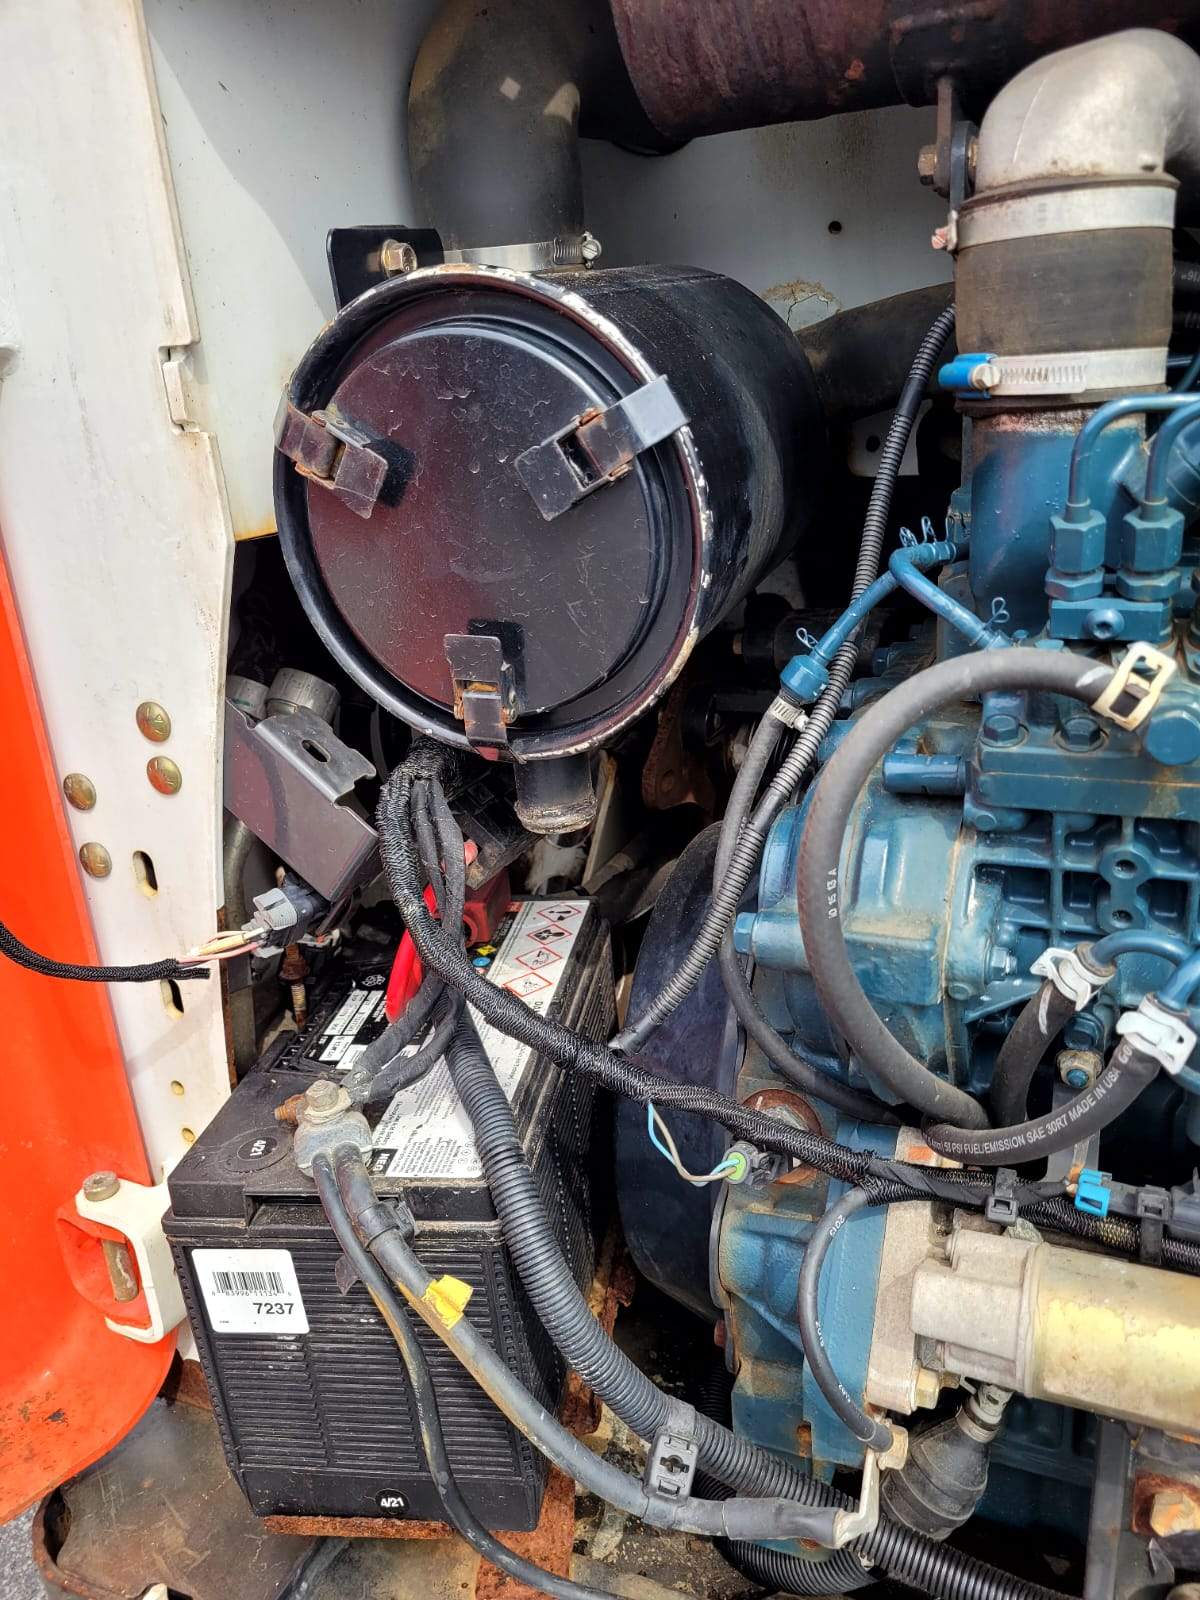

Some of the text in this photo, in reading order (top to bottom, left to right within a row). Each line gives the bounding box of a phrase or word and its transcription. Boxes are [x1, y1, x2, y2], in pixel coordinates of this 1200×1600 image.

[828, 867, 837, 875] A
[952, 1142, 963, 1154] PSI
[1026, 1127, 1046, 1143] SAE
[1045, 1113, 1068, 1135] 30R7
[1067, 1093, 1097, 1122] MADE
[1093, 1083, 1107, 1100] IN
[1103, 1067, 1121, 1089] USA
[250, 1139, 267, 1157] 4/21
[253, 1302, 294, 1315] 7237
[380, 1496, 405, 1508] 4/21
